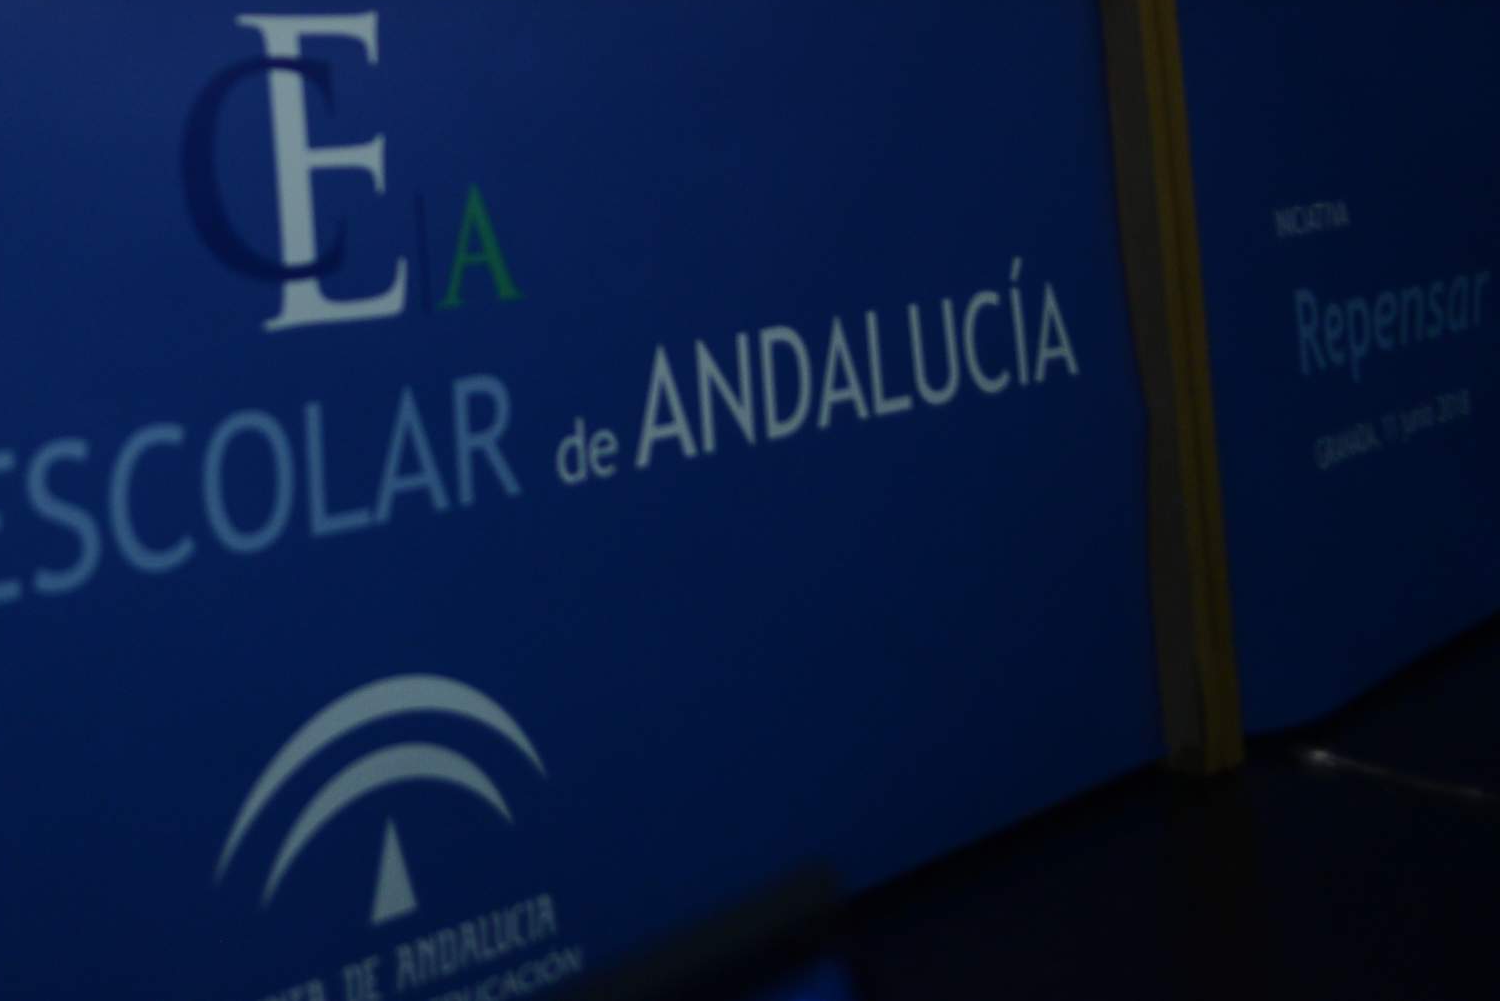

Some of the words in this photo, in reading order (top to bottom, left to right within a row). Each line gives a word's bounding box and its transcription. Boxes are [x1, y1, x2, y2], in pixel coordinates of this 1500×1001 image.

[555, 416, 619, 485] de
[634, 256, 1080, 469] ANDALUCÍA
[1294, 269, 1491, 385] Repensar
